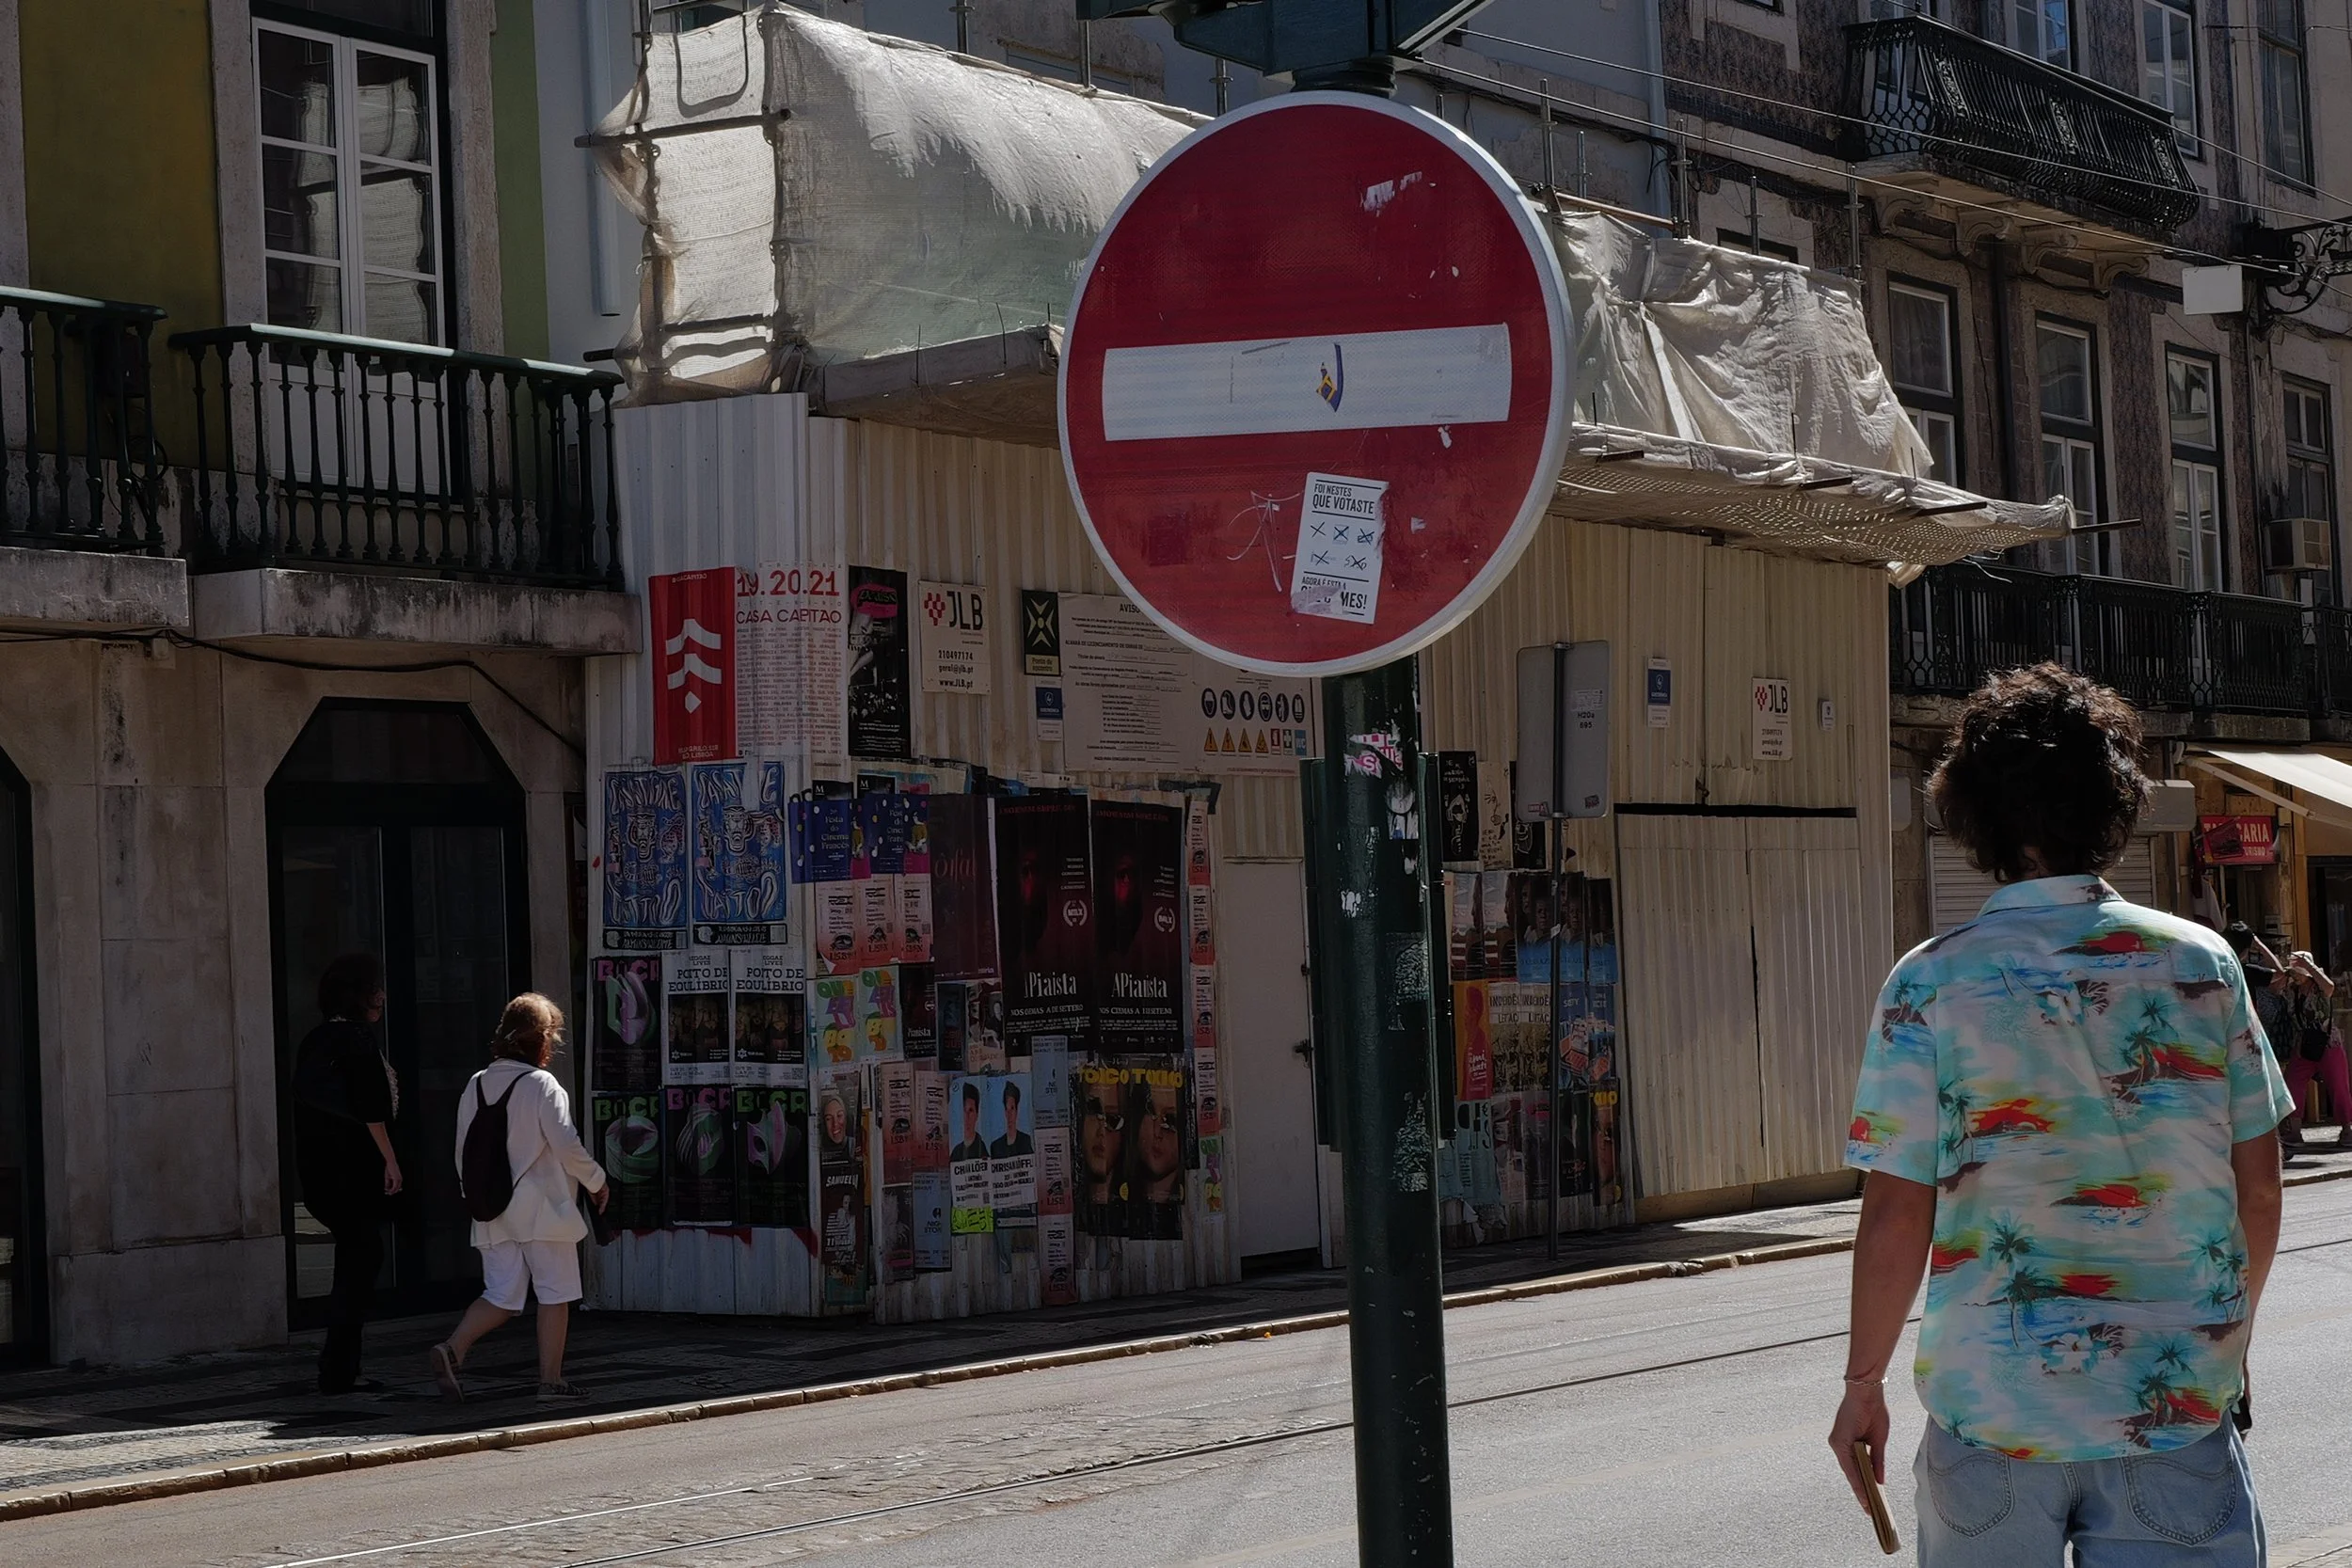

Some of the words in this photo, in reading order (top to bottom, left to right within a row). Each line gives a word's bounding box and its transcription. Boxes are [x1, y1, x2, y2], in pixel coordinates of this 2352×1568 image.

[1314, 483, 1325, 493] FOI
[1327, 485, 1352, 497] NESTES
[1312, 494, 1330, 510] QUE
[1333, 497, 1375, 514] VOTASTE
[738, 569, 840, 596] 19.20.21
[1302, 577, 1322, 586] AGORA
[737, 610, 772, 624] CASA
[946, 591, 983, 630] JLB
[939, 650, 973, 660] 210497174
[1768, 685, 1788, 713] JLB
[787, 969, 804, 978] DE
